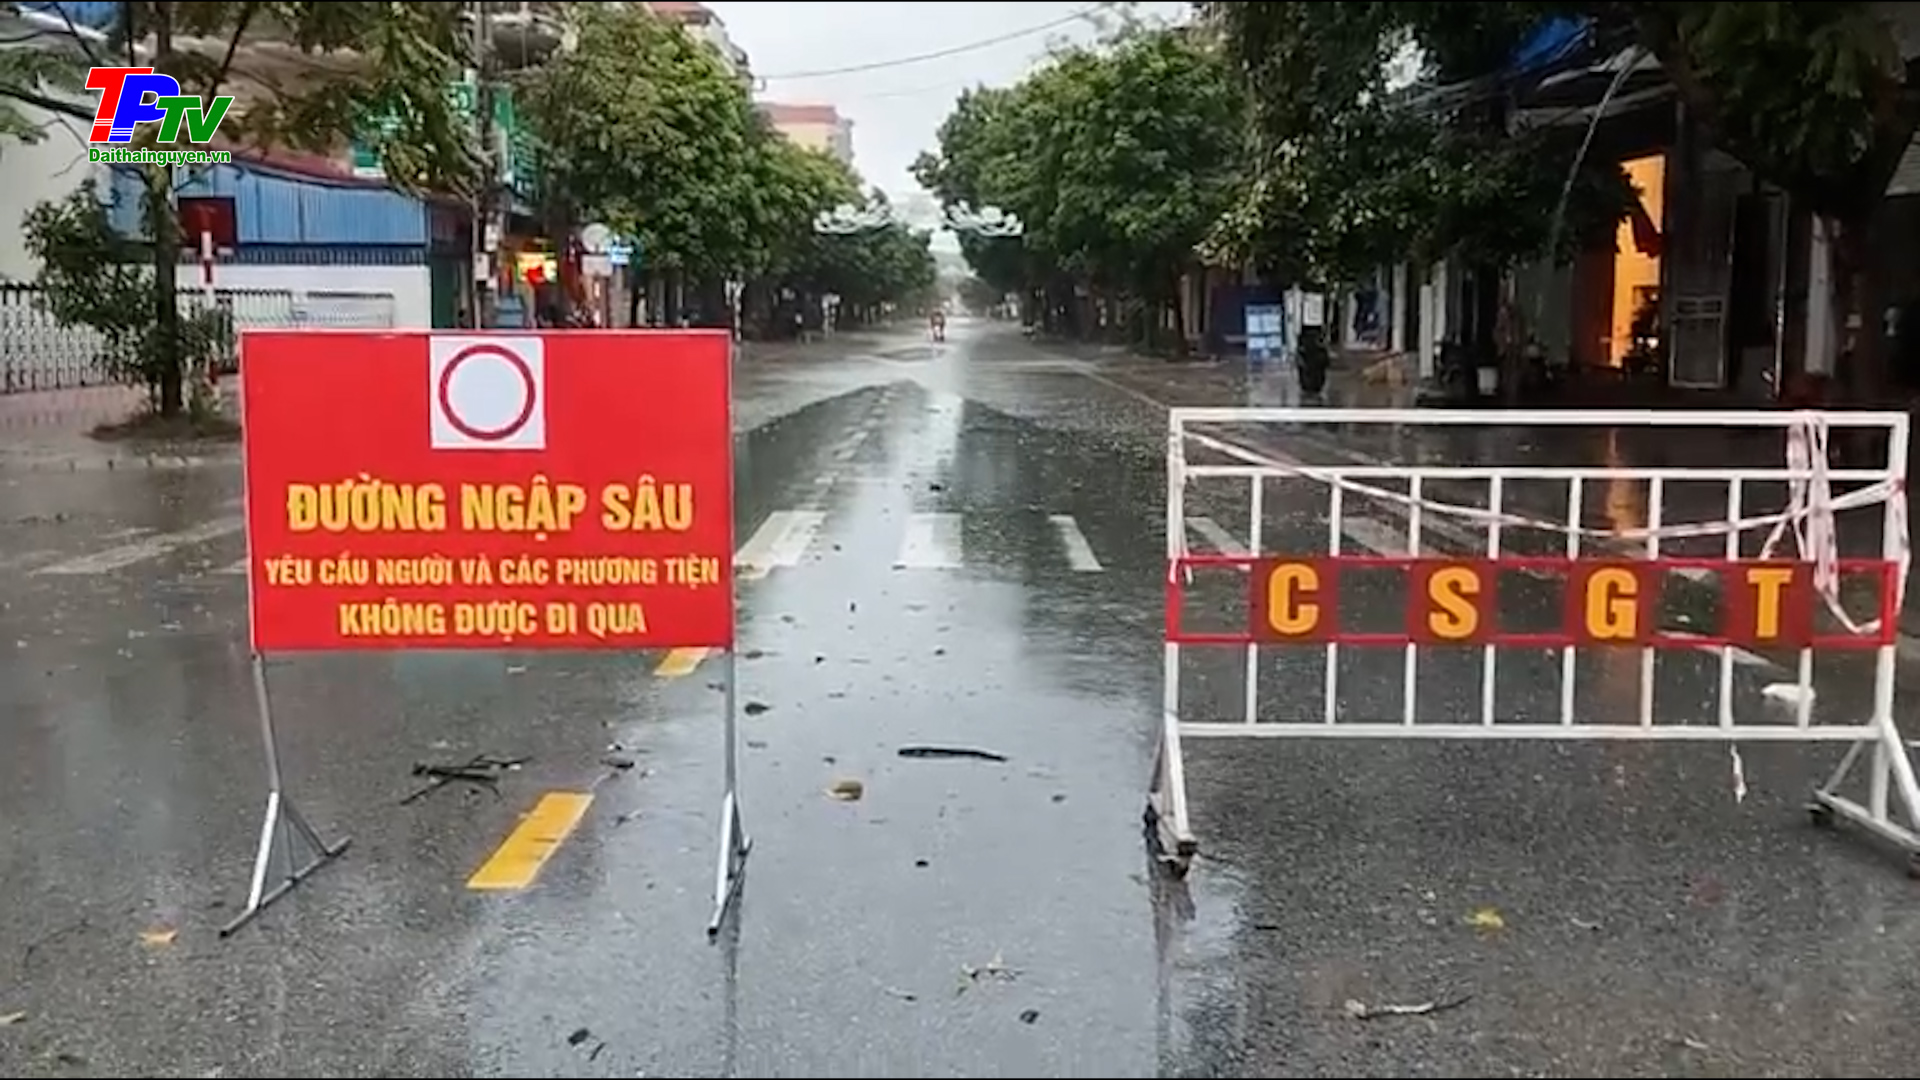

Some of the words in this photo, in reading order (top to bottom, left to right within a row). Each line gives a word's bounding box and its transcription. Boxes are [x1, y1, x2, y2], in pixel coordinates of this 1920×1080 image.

[286, 472, 446, 531] ĐƯỜNG
[461, 474, 587, 541] NGẬP
[601, 474, 693, 531] SÂU
[265, 554, 313, 585] YÊU
[376, 553, 453, 585] NGƯỜI
[460, 553, 493, 585] VÀ
[500, 554, 550, 585] CÁC
[556, 556, 659, 585] PHƯƠNG
[664, 554, 719, 589] TIỆN
[339, 597, 447, 635] KHÔNG
[454, 600, 538, 643] ĐƯỢC
[546, 602, 578, 634] ĐI
[586, 602, 647, 639] QUA
